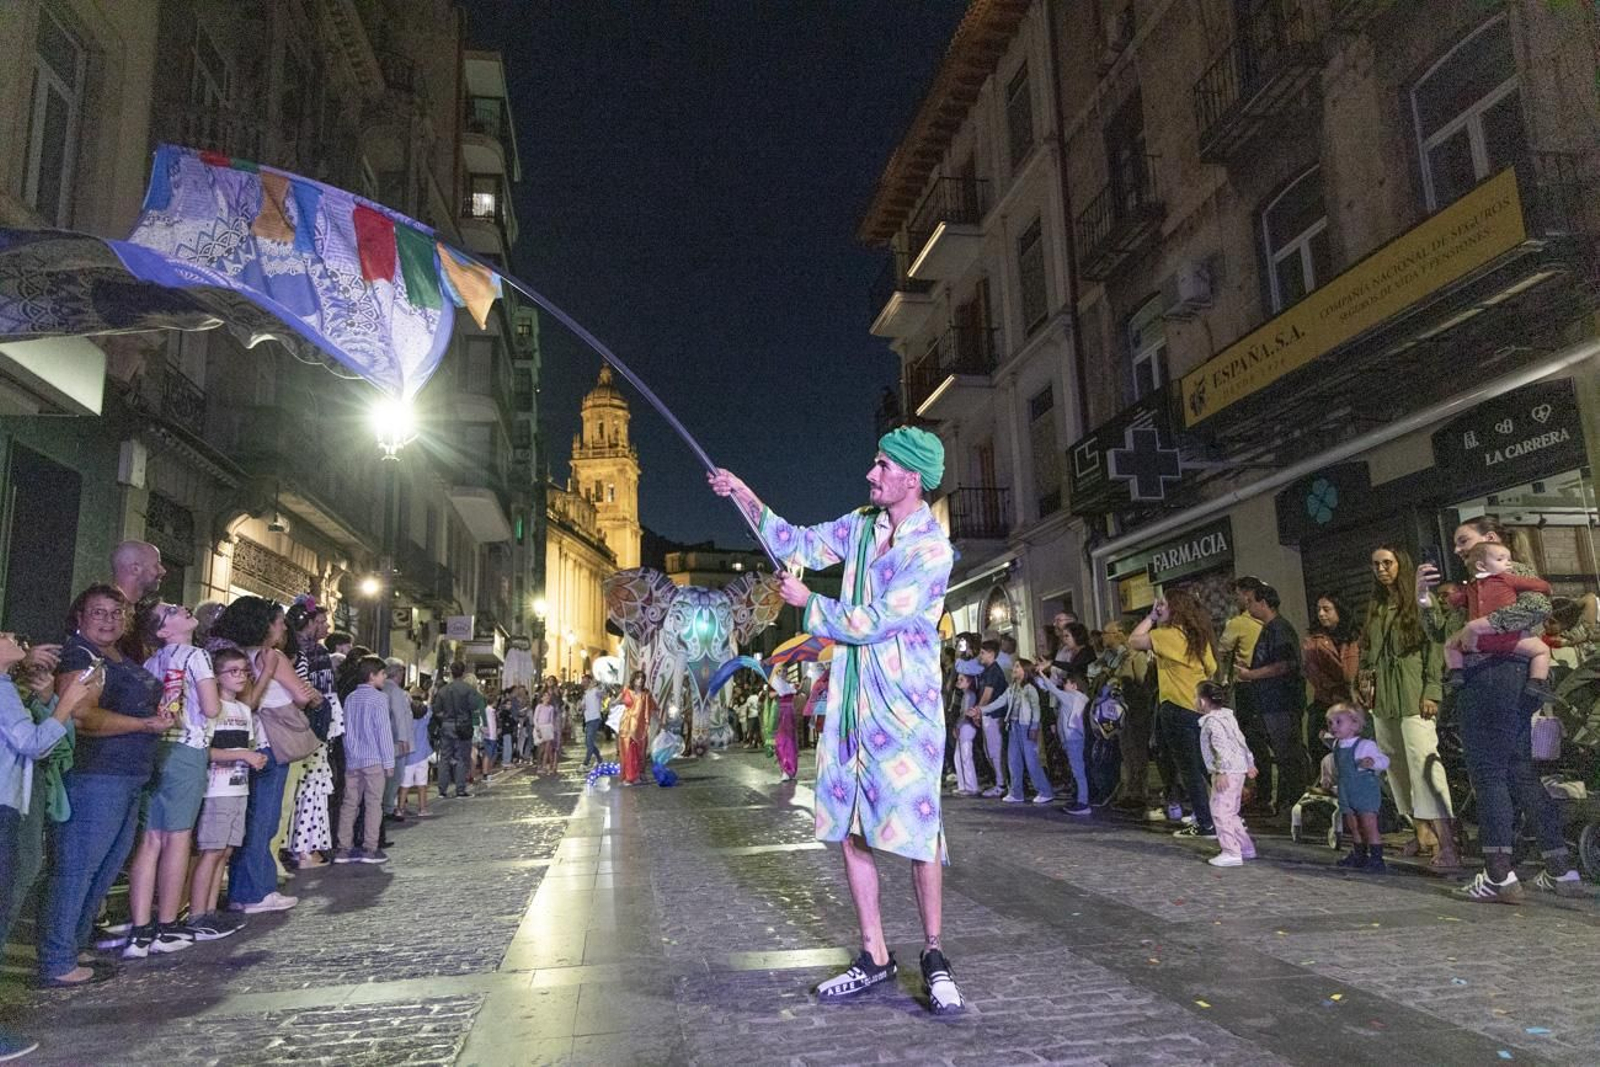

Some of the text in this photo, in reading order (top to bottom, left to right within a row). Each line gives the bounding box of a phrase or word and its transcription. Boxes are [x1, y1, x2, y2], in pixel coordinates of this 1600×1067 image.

[1485, 428, 1571, 466] LA CARRERA
[1152, 532, 1228, 573] FARMACIA
